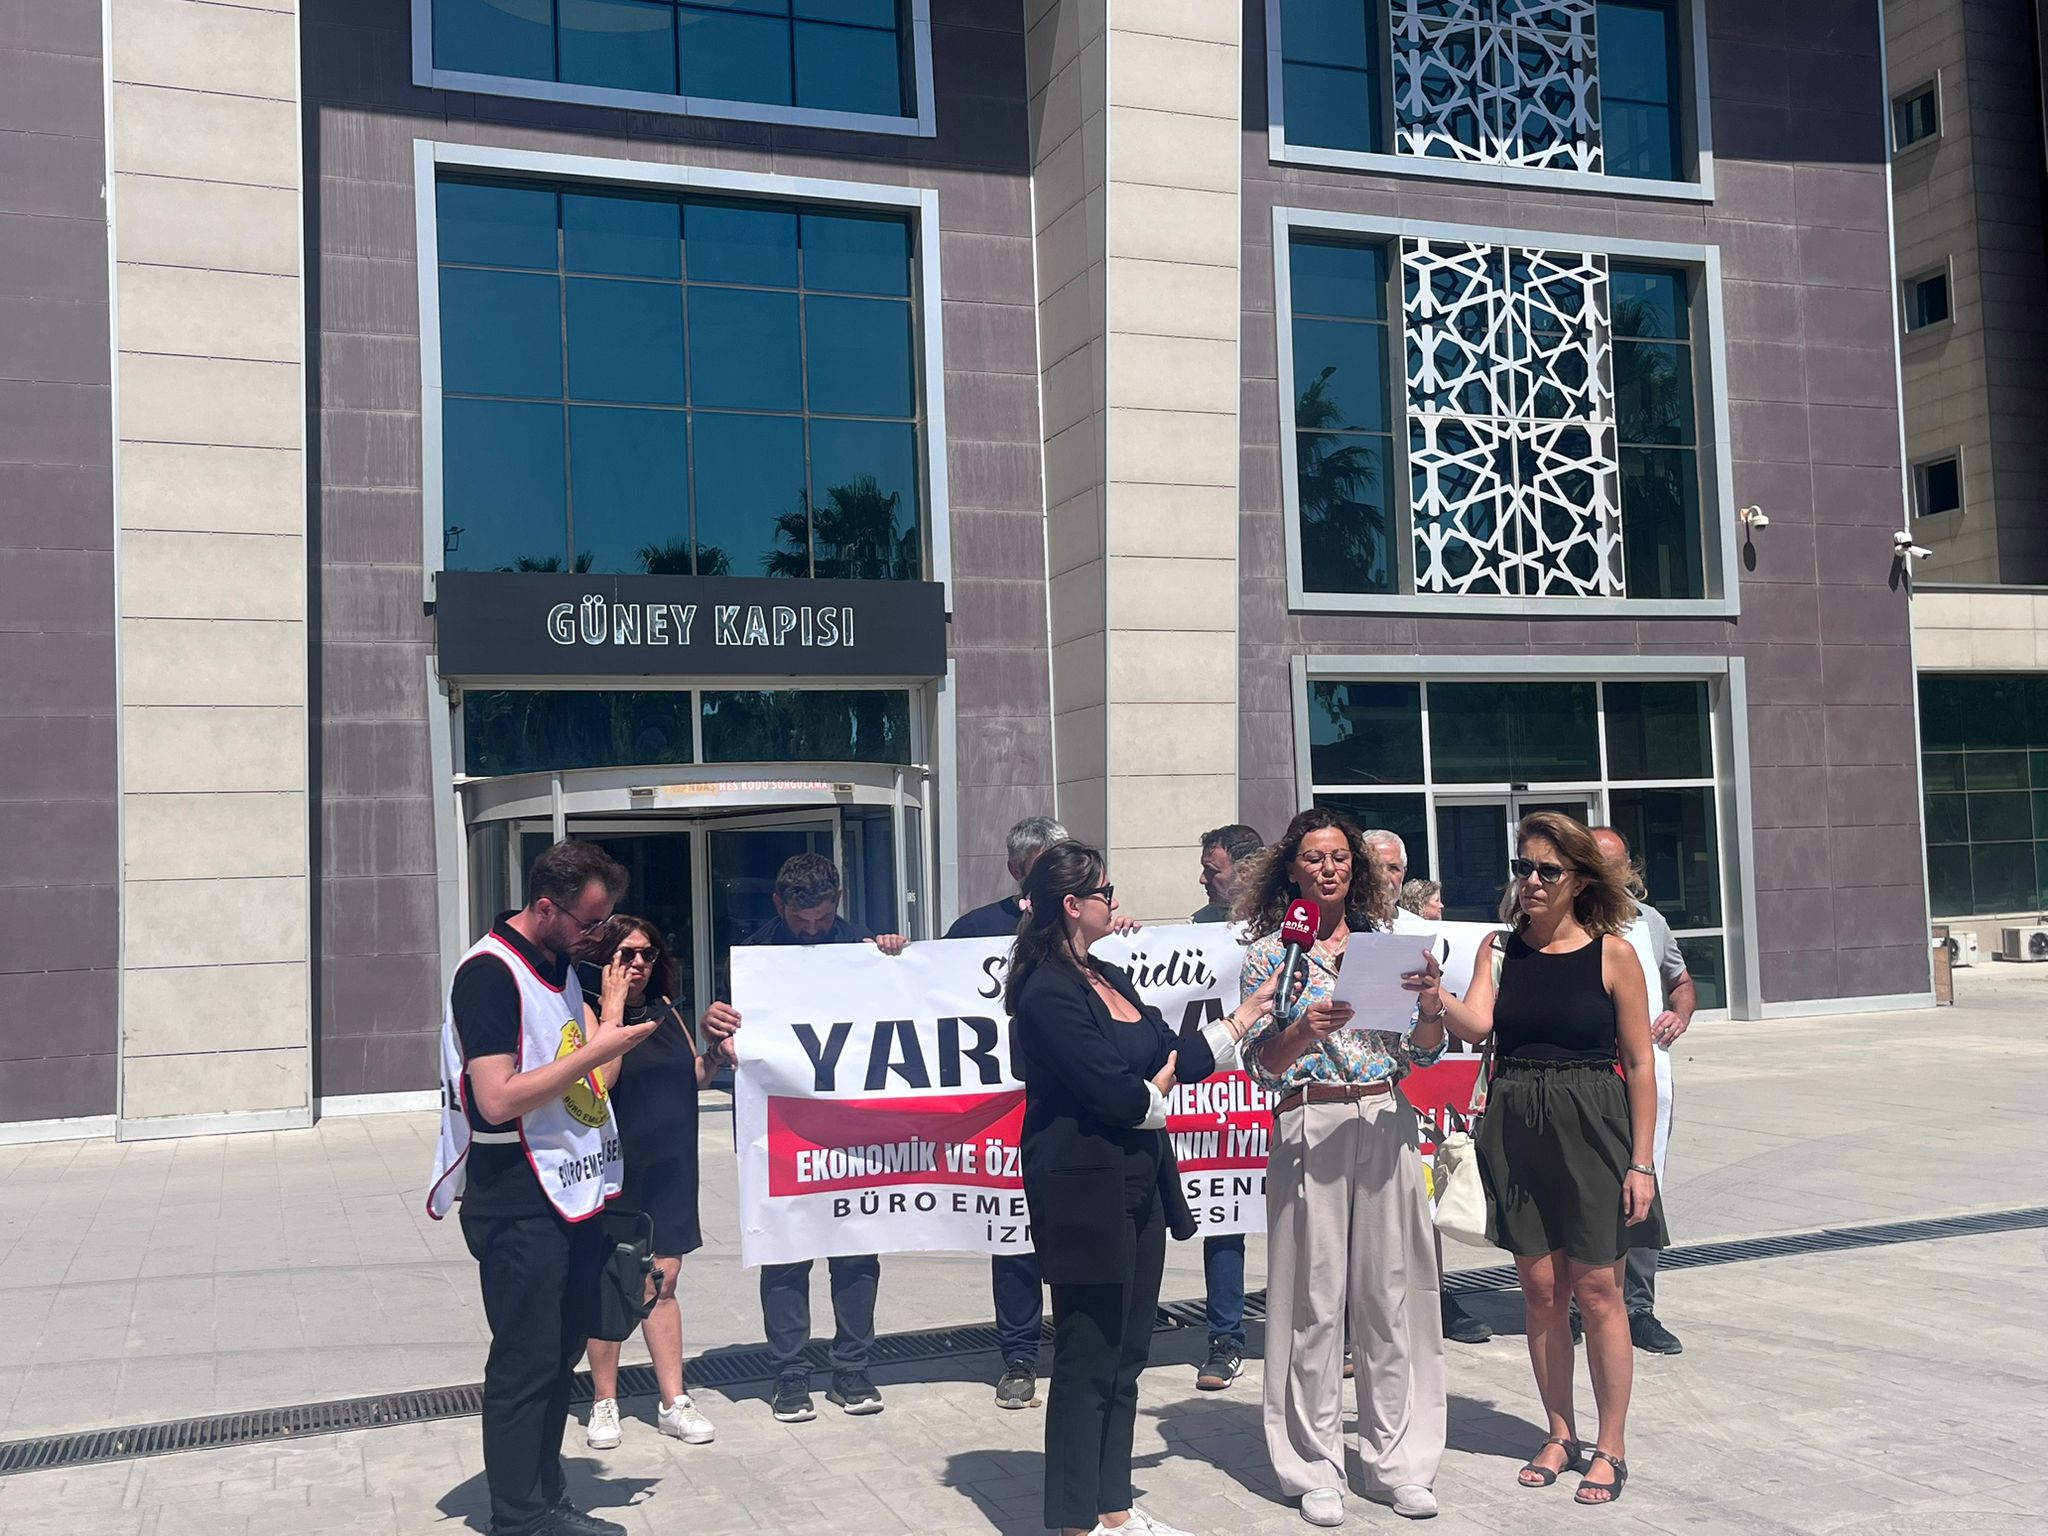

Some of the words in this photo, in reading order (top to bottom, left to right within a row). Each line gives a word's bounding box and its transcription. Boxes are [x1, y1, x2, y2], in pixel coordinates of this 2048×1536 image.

[547, 594, 697, 645] GÜNEY
[715, 604, 855, 647] KAPISI
[1284, 920, 1310, 932] anka
[791, 1015, 1027, 1092] YAR
[796, 1135, 938, 1183] EKONOMİK
[945, 1142, 978, 1175] VE
[833, 1190, 938, 1218] BÜRO
[1186, 1176, 1267, 1200] SEN
